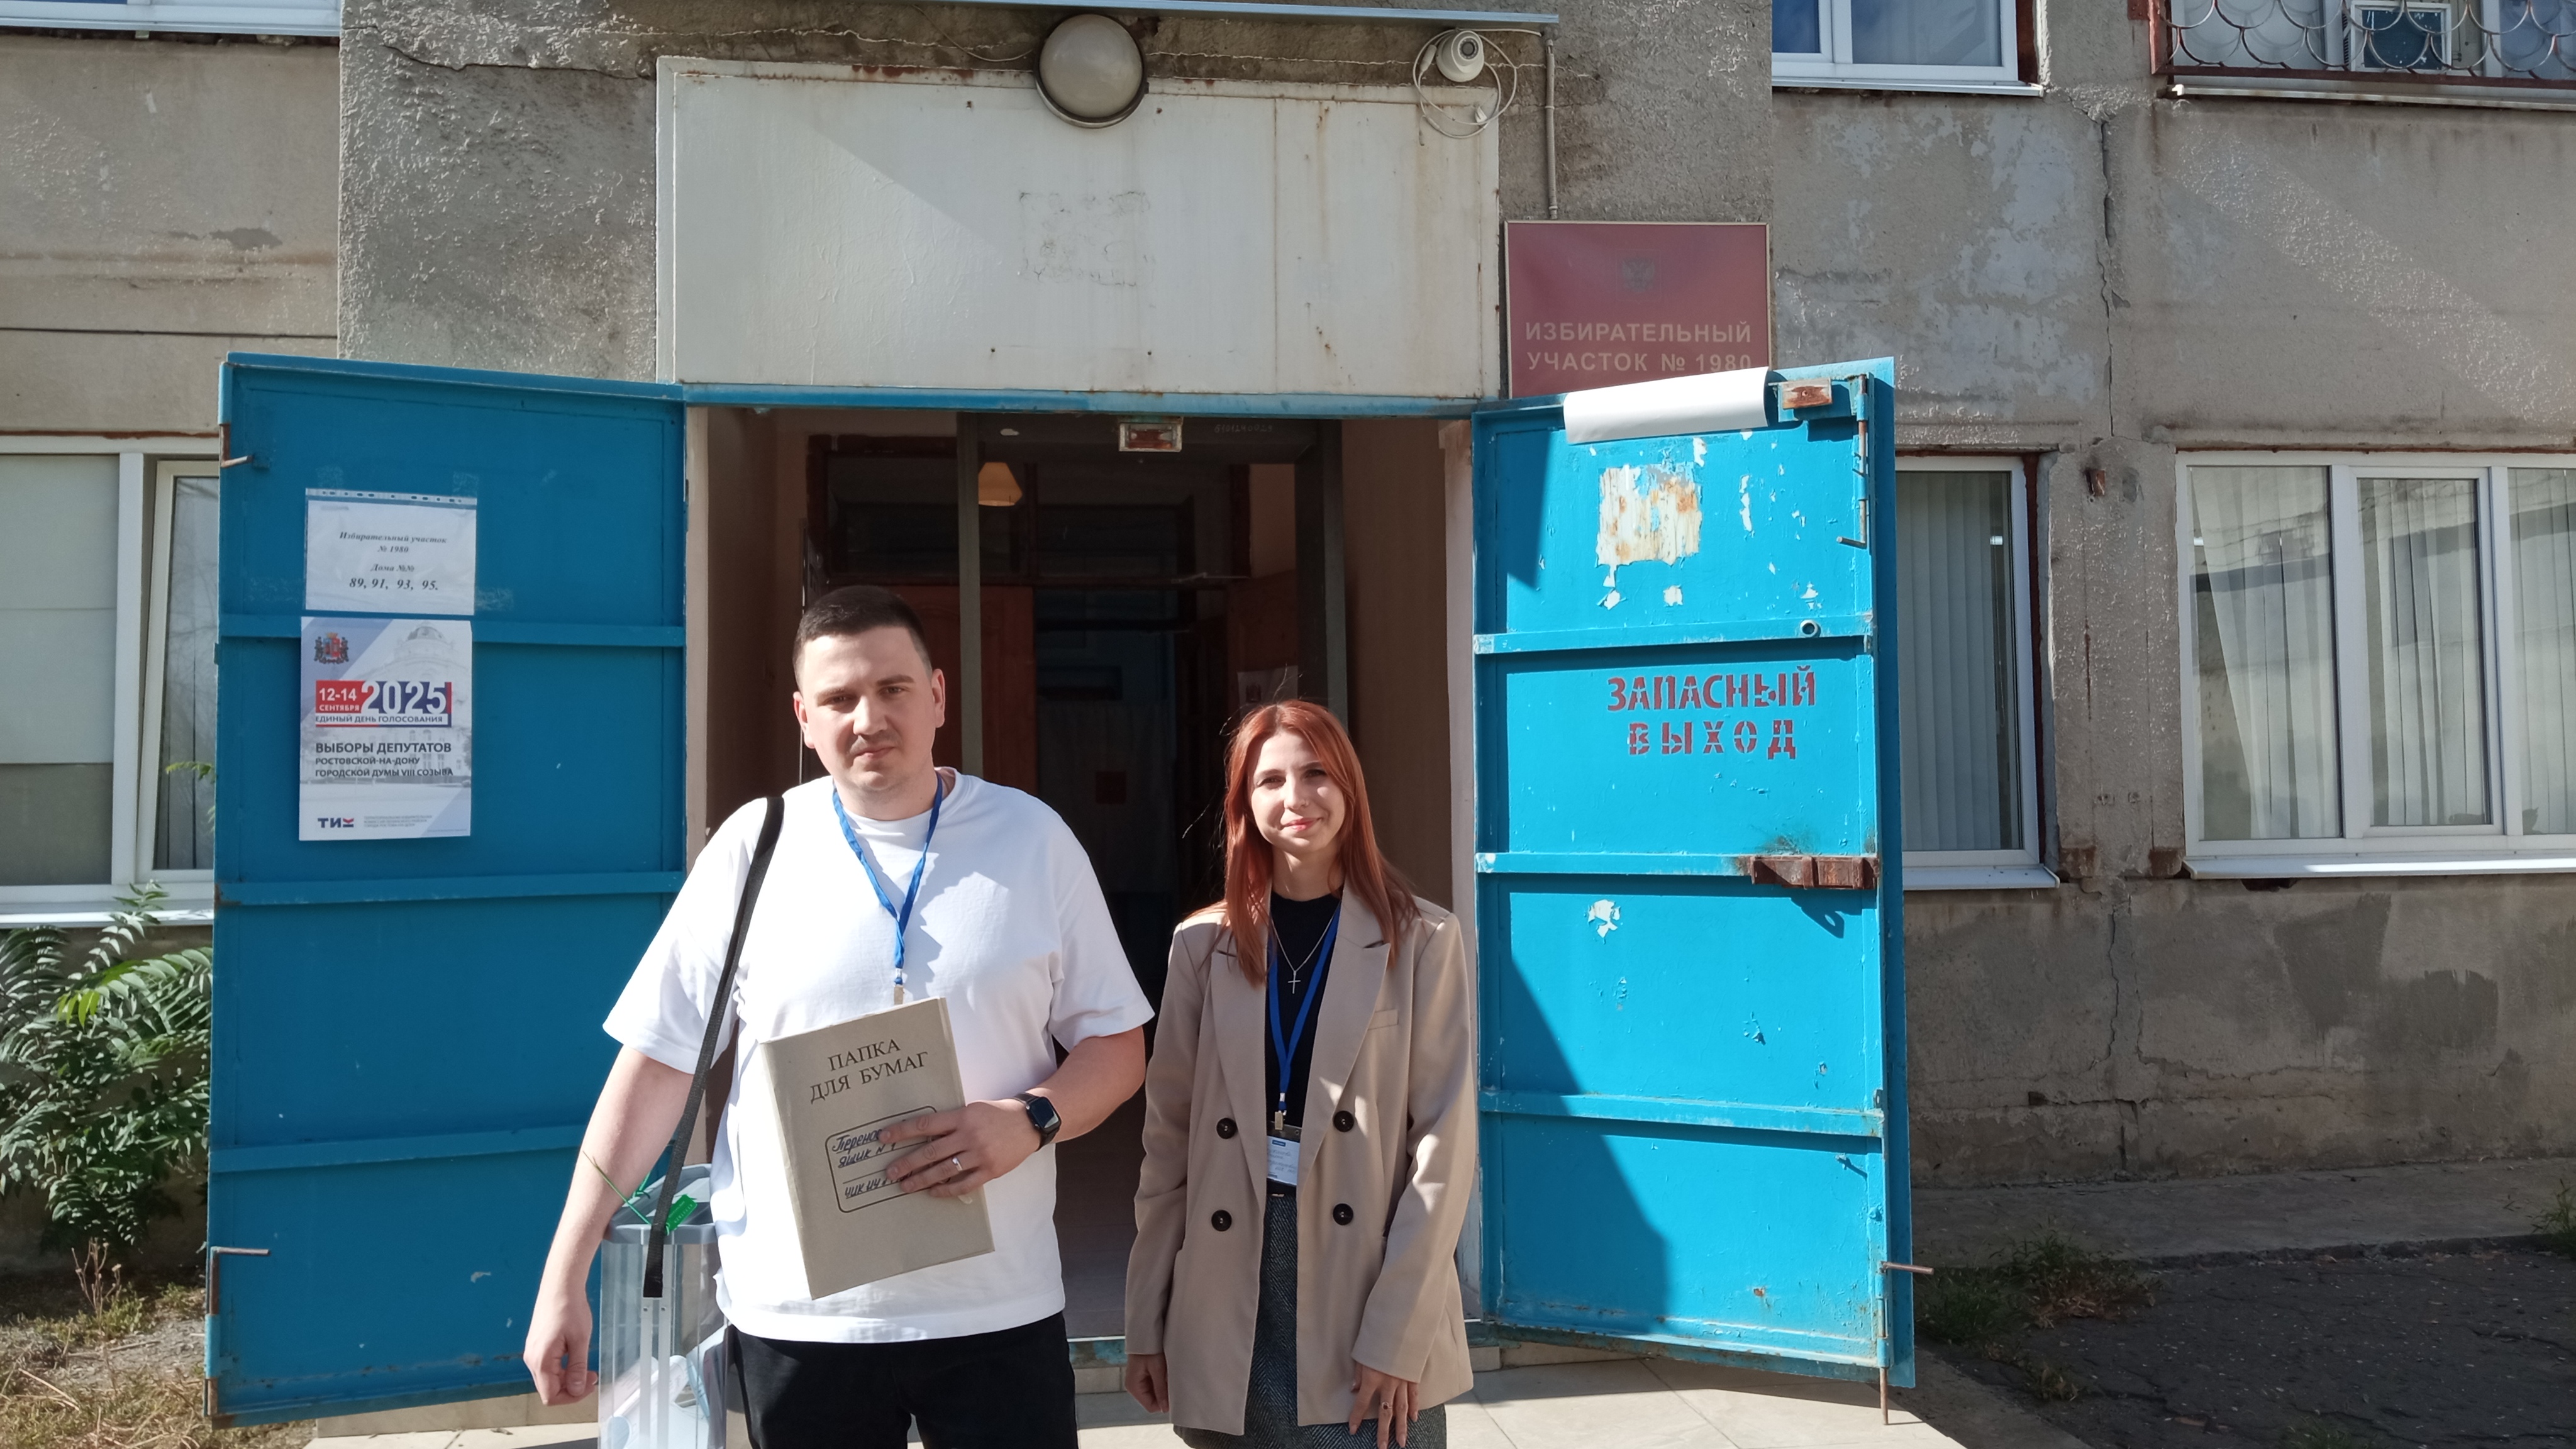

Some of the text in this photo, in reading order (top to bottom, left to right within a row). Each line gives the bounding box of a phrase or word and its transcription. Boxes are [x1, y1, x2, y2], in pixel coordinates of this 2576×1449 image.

[1525, 321, 1751, 343] ИЗБИРАТЕЛЬНЫЙ
[1526, 352, 1752, 372] УЧАСТОК № 1980
[340, 531, 409, 541] Избирательный
[349, 577, 438, 591] 89, 91, 93, 95.
[319, 680, 447, 714] 12-14 2025
[1607, 664, 1816, 712] ЗАПАСНЫЙ
[316, 714, 353, 723] ЕДИНЫЙ
[316, 743, 452, 754] ВЫБОРЫ ДЕПУТАТОВ
[1628, 719, 1797, 760] ВЫХОД
[315, 769, 370, 777] ГОРОДСКОЙ
[372, 769, 399, 777] ДУМЫ
[828, 1039, 901, 1072] ПАПКА
[810, 1052, 929, 1105] ДЛЯ БУМАГ
